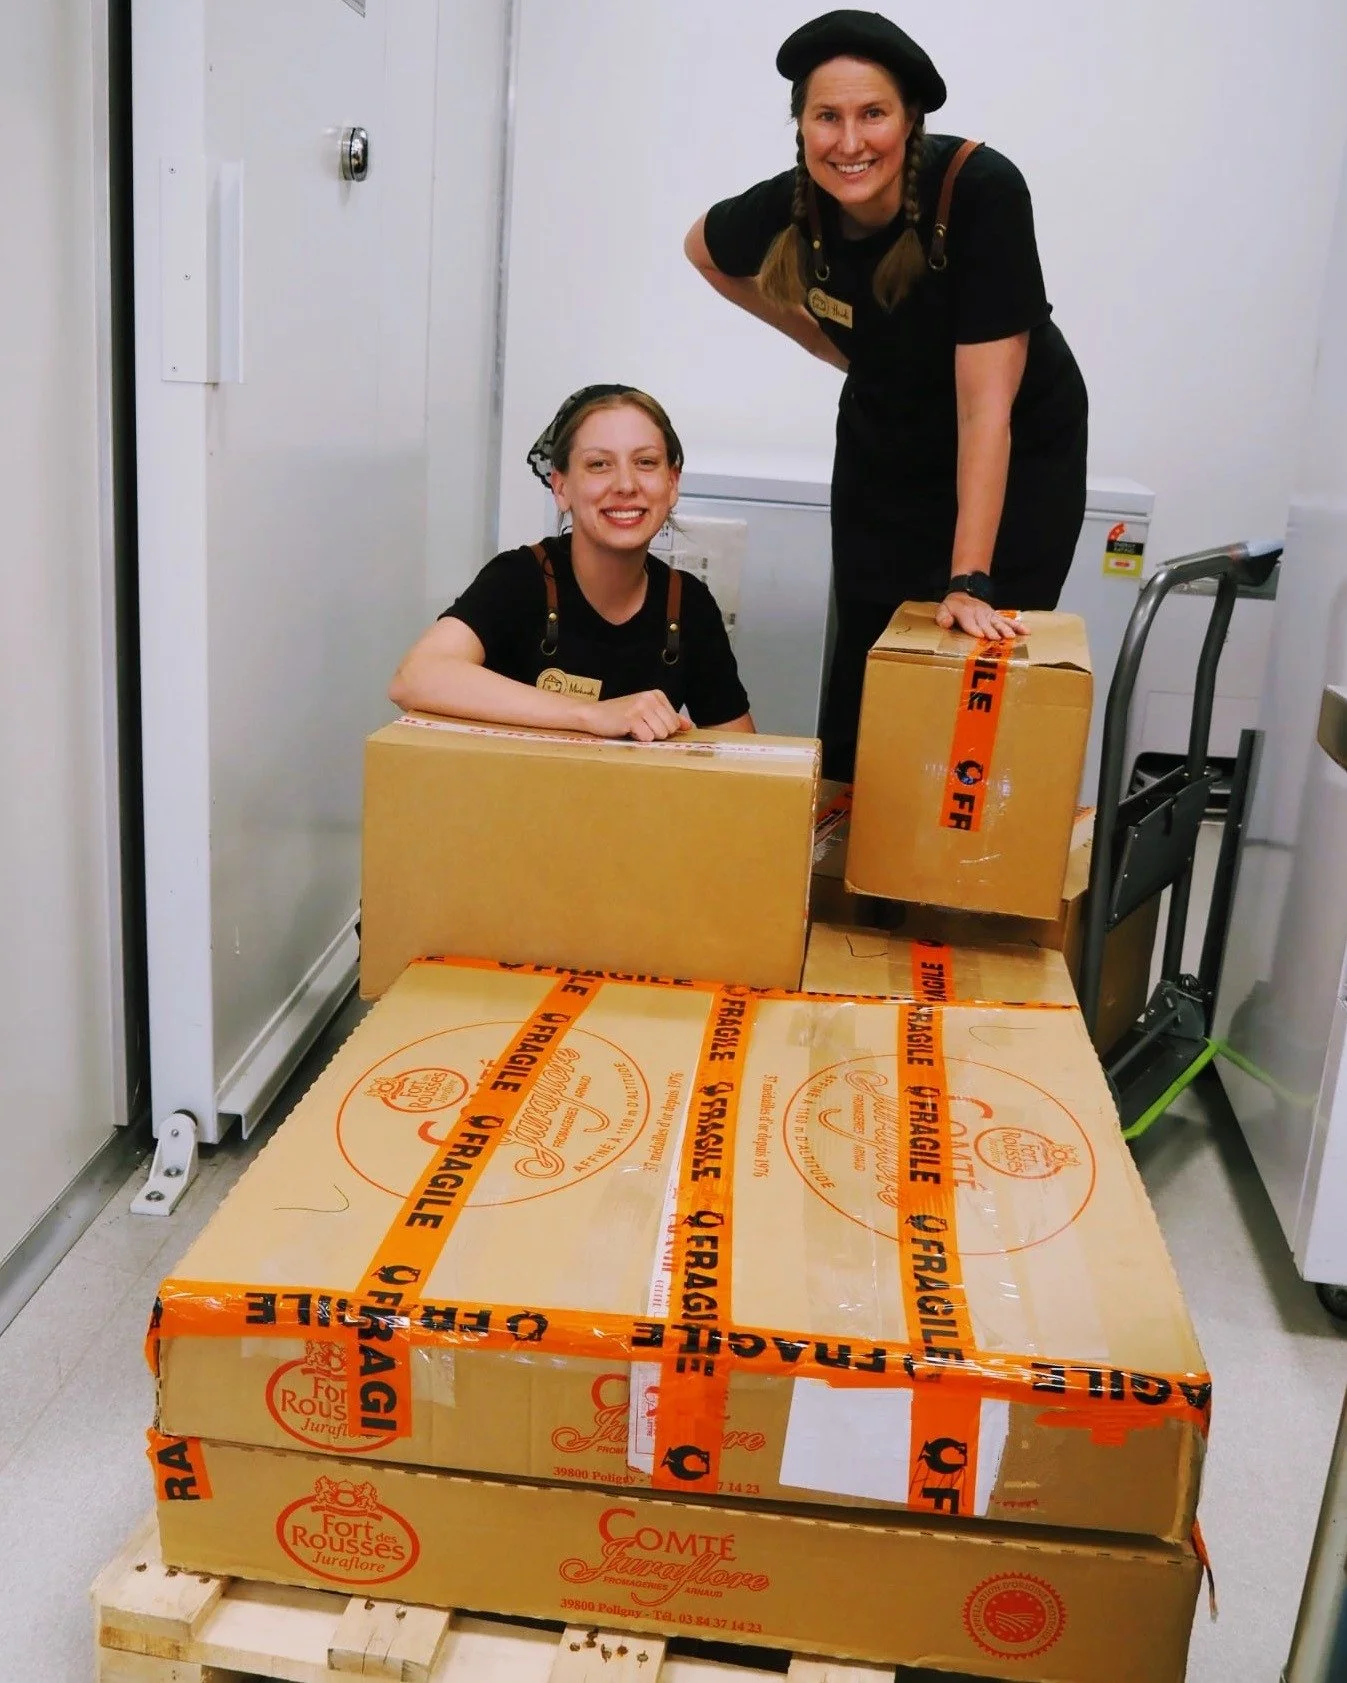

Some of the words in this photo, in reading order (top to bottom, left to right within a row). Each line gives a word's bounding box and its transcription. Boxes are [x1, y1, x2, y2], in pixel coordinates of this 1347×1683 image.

[708, 997, 747, 1062] FRAGILE
[489, 1023, 560, 1094] FRAGILE
[690, 1097, 728, 1182] FRAGILE
[795, 1136, 837, 1190] D'ALTITUDE
[908, 1100, 942, 1185] FRAGILE
[404, 1131, 490, 1230] FRAGILE
[910, 1236, 966, 1366] FRAGILE
[281, 1388, 348, 1422] Rous
[553, 1465, 589, 1480] 39800
[728, 1481, 742, 1493] 14
[746, 1482, 761, 1494] 23
[291, 1524, 406, 1561] Rousses
[322, 1513, 374, 1541] Fort
[374, 1532, 398, 1544] des
[598, 1507, 738, 1562] COMTÉ
[311, 1550, 386, 1573] Juraflore
[602, 1576, 669, 1592] FROMAGERIES
[684, 1586, 723, 1599] ARNAUD
[560, 1598, 595, 1612] 39800
[598, 1603, 643, 1620] Poligny
[652, 1609, 676, 1623] Tél.
[679, 1613, 692, 1625] 03
[713, 1618, 728, 1630] 37
[732, 1620, 746, 1632] 14
[747, 1622, 763, 1634] 23
